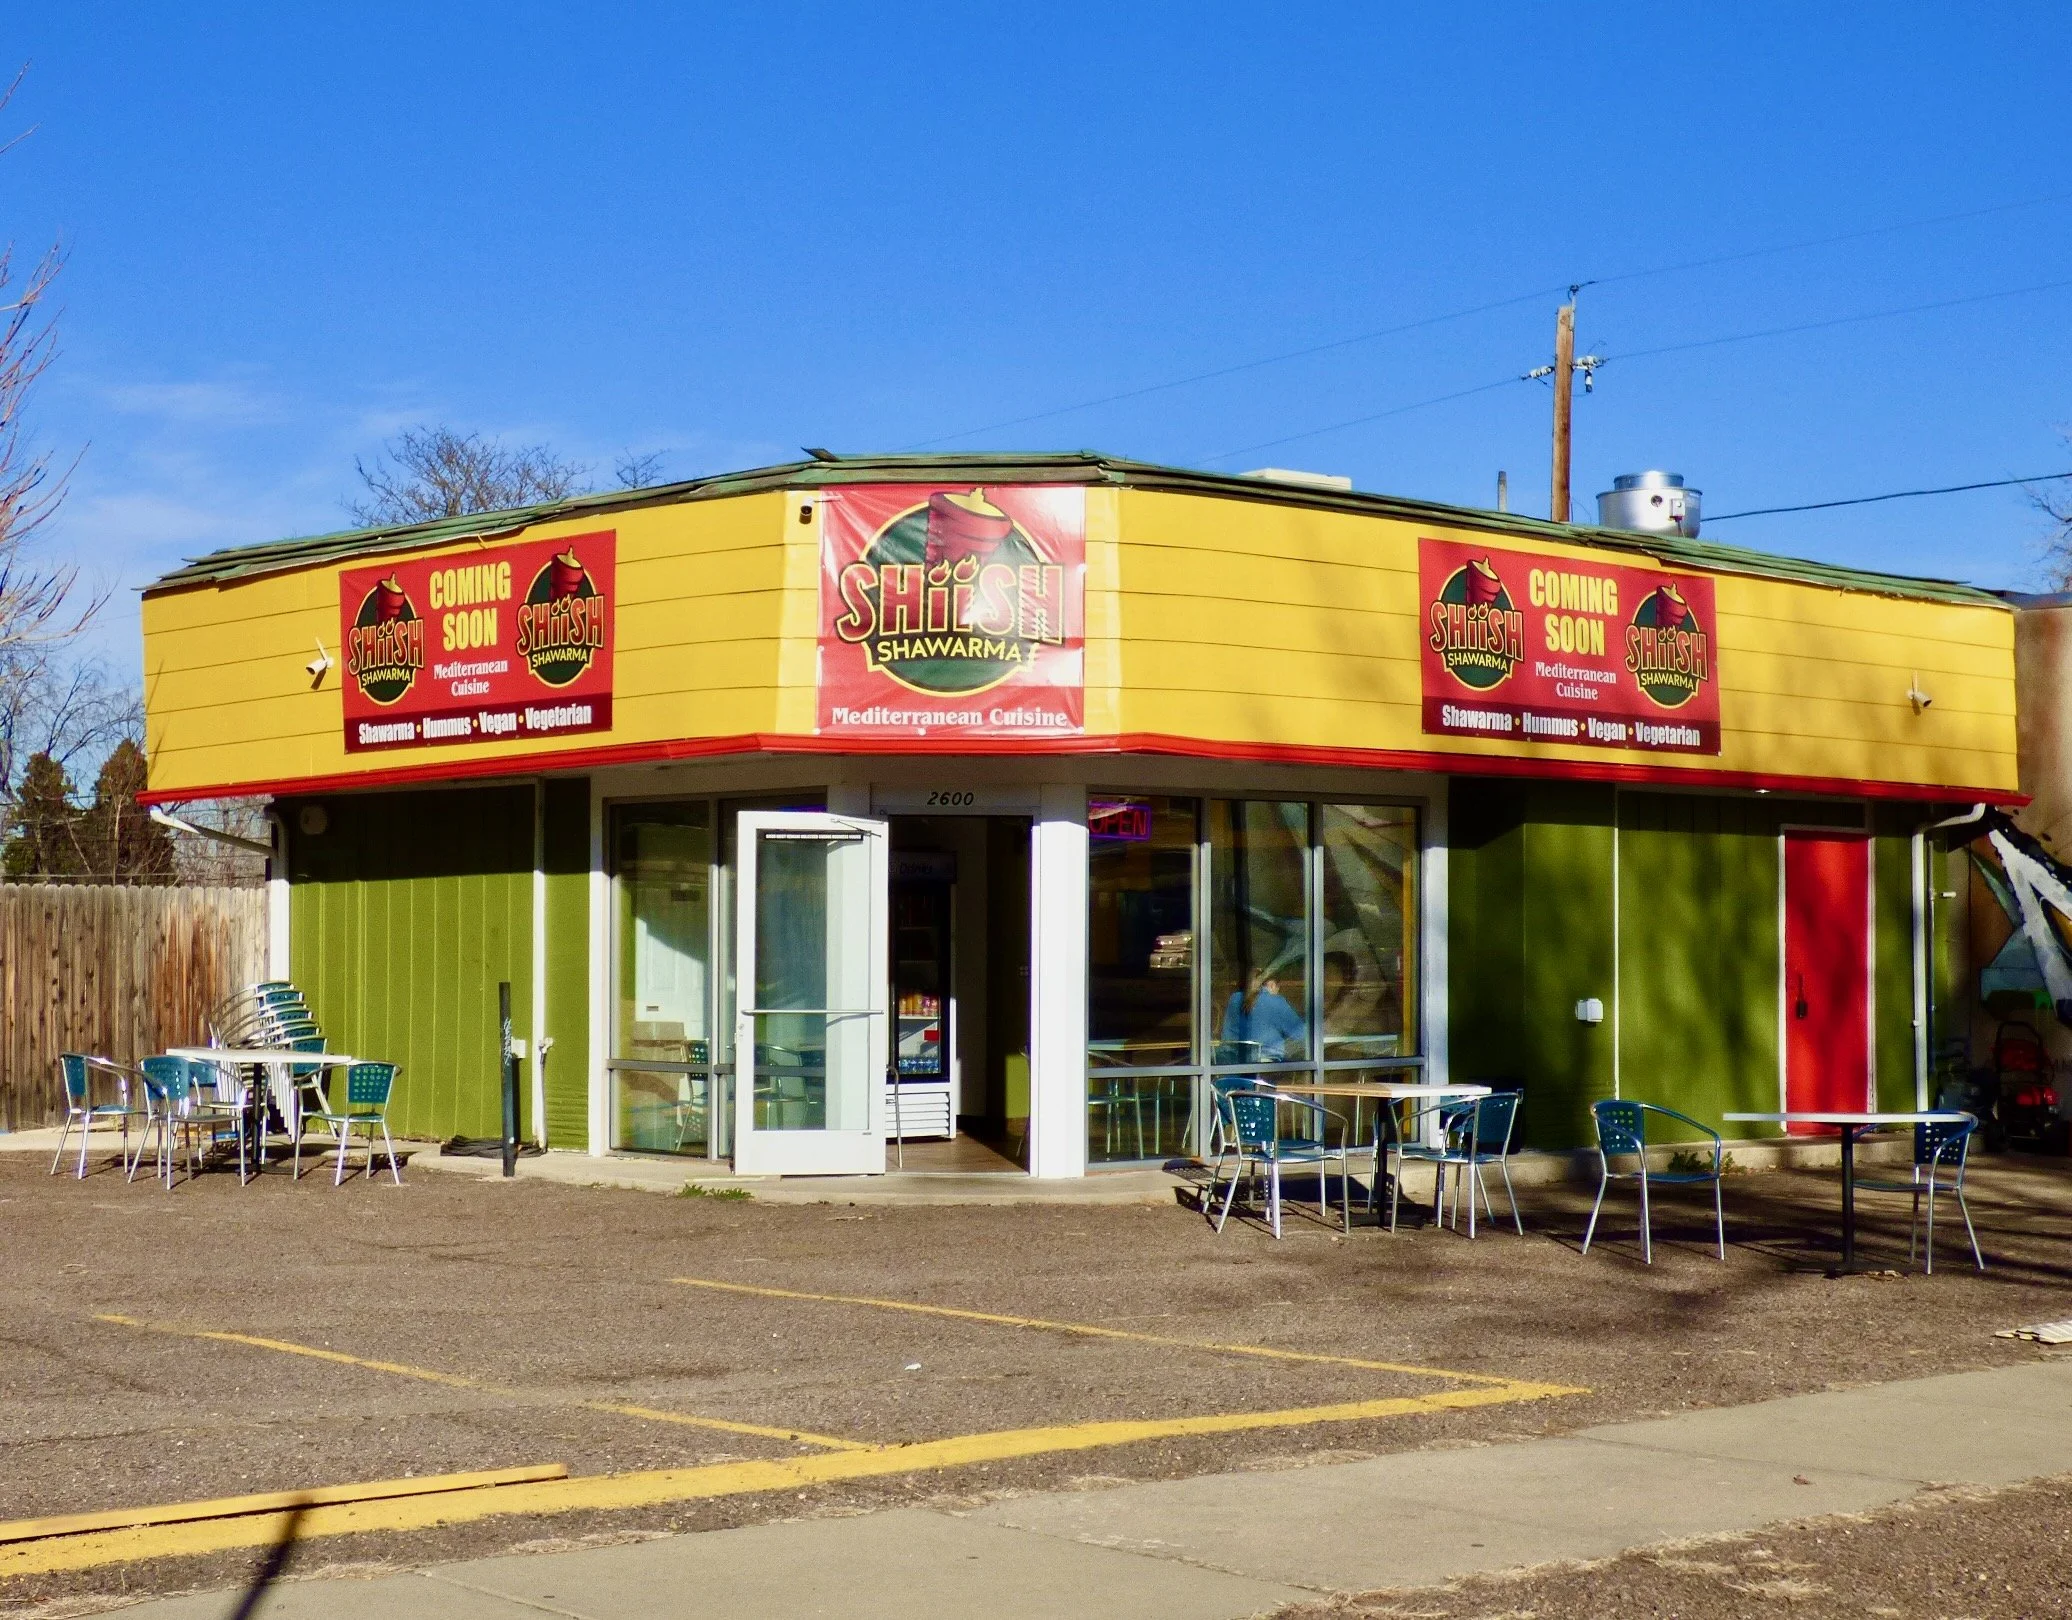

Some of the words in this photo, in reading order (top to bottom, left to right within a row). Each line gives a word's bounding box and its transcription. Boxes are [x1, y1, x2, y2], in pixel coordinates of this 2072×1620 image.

[429, 561, 512, 609] COMING
[1529, 568, 1619, 616] COMING
[442, 608, 497, 651] SOON
[1545, 614, 1606, 656] SOON
[531, 648, 588, 668] SHAWARMA
[878, 636, 1022, 662] SHAWARMA
[433, 660, 508, 680] Mediterranean
[1447, 652, 1508, 672] SHAWARMA
[1535, 661, 1617, 684] Mediterranean
[361, 669, 411, 687] SHAWARMA
[451, 680, 490, 697] Cuisine
[1640, 673, 1694, 691] SHAWARMA
[1555, 682, 1598, 700] Cuisine
[358, 722, 415, 745] Shawarma
[422, 717, 472, 739] Hummus
[478, 711, 517, 735] Vegan
[525, 703, 592, 730] Vegetarian
[832, 706, 983, 726] Mediterranean
[989, 706, 1067, 727] Cuisine
[1442, 705, 1512, 731] Shawarma
[1522, 712, 1578, 736] Hummus
[1588, 717, 1627, 742] Vegan
[1635, 722, 1701, 747] Vegetarian
[926, 791, 974, 806] 2600
